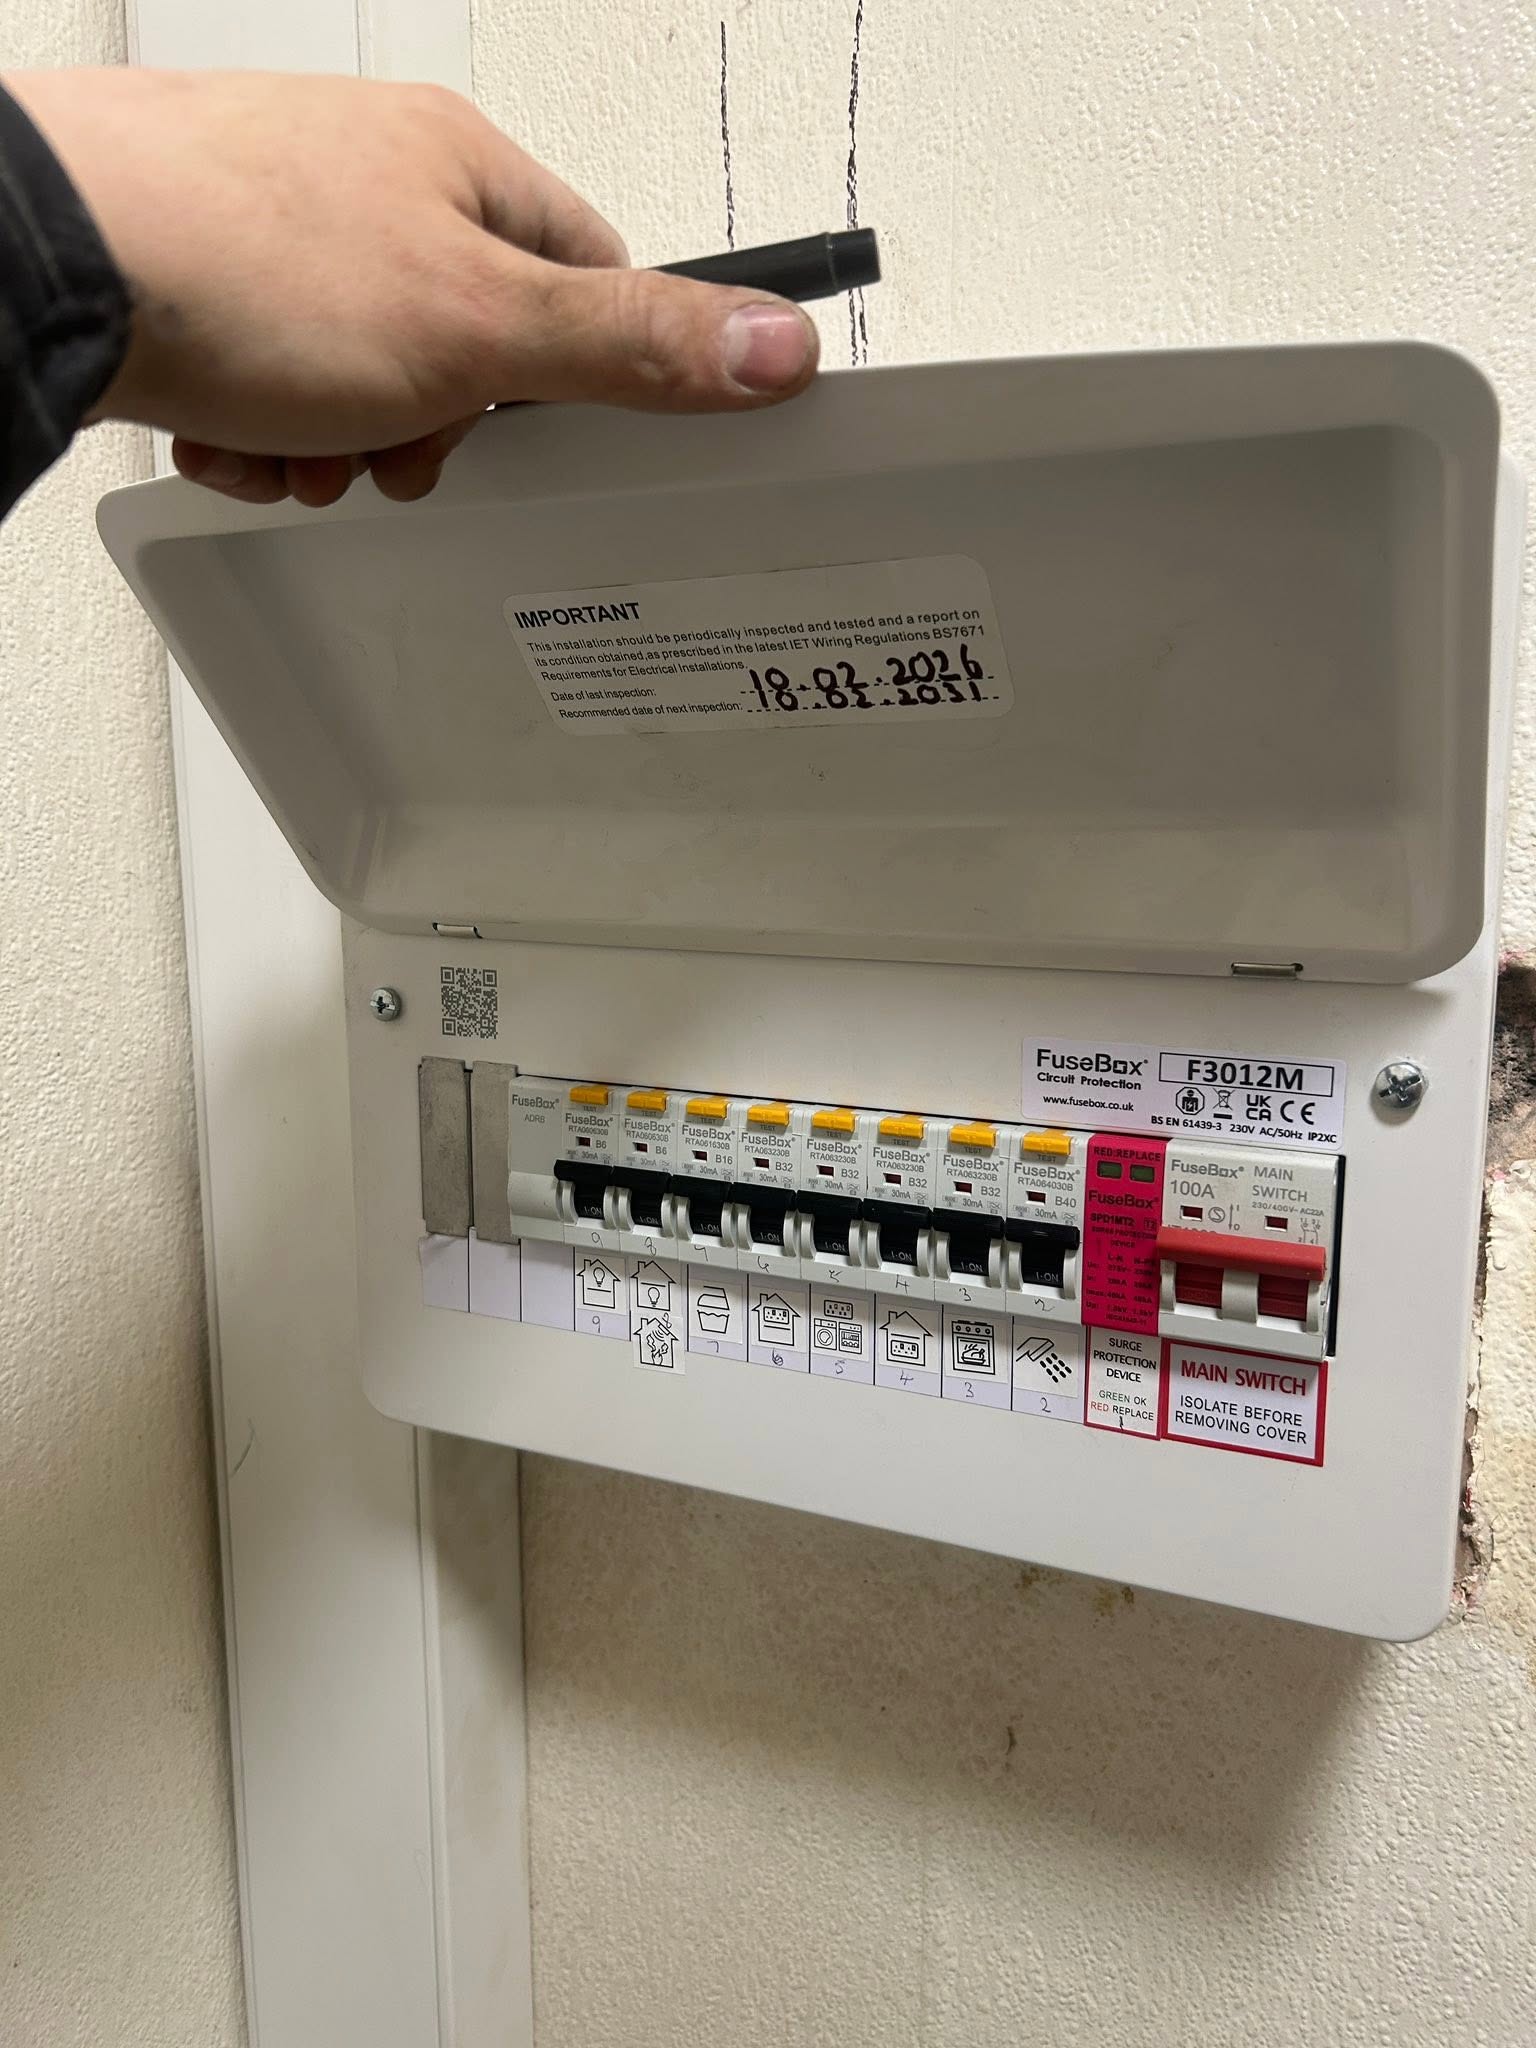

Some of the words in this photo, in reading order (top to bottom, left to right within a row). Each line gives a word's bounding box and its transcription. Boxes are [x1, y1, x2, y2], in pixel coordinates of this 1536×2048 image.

[514, 602, 640, 629] IMPORTANT
[527, 642, 551, 653] This
[553, 637, 614, 651] installation
[616, 634, 653, 647] should
[655, 633, 671, 644] be
[673, 627, 741, 645] periodically
[744, 623, 804, 639] inspected
[808, 620, 831, 632] and
[834, 616, 875, 630] tested
[878, 615, 903, 627] and
[906, 615, 915, 624] a
[917, 610, 959, 625] report
[962, 609, 980, 620] on
[534, 657, 548, 667] its
[549, 654, 597, 667] condition
[597, 650, 661, 664] obtained,as
[662, 644, 721, 660] prescribed
[723, 644, 733, 654] in
[734, 642, 754, 653] the
[756, 640, 787, 652] latest
[790, 638, 814, 650] IET
[813, 634, 853, 649] Wiring
[855, 628, 931, 646] Regulations
[933, 625, 984, 640] BS7671
[540, 668, 612, 683] Requirements
[612, 667, 628, 677] for
[629, 662, 678, 676] Electrical
[678, 660, 749, 673] Installations.
[551, 691, 574, 702] Date
[575, 690, 585, 700] of
[585, 689, 604, 699] last
[604, 687, 657, 700] inspection:
[559, 705, 631, 719] Recommended
[632, 705, 654, 716] date
[655, 704, 664, 714] of
[666, 704, 687, 714] next
[688, 701, 743, 715] inspection:
[1037, 1072, 1075, 1084] Circuit
[1080, 1075, 1142, 1090] Protection
[1187, 1059, 1304, 1091] F3012M
[1043, 1095, 1134, 1112] www.fusebox.co.uk
[1246, 1093, 1272, 1109] UK
[1151, 1116, 1163, 1126] BS
[1166, 1117, 1180, 1127] EN
[1182, 1119, 1222, 1132] 61439-3
[1230, 1124, 1255, 1135] 230V
[1259, 1128, 1303, 1140] AC/50Hz
[1308, 1132, 1337, 1144] IP2XC
[596, 1140, 607, 1149] B6
[655, 1145, 667, 1155] B6
[744, 1145, 790, 1157] RTA063230B
[963, 1146, 982, 1154] TEST
[715, 1155, 733, 1165] B16
[810, 1152, 856, 1164] RTA063230B
[1037, 1154, 1057, 1162] TEST
[699, 1166, 718, 1176] 30mA
[775, 1162, 793, 1172] B32
[876, 1160, 924, 1172] RTA063230B
[1254, 1166, 1293, 1181] MAIN
[759, 1174, 778, 1183] 30mA
[841, 1169, 859, 1179] B32
[946, 1169, 998, 1181] RTA063230B
[824, 1181, 844, 1190] 30mA
[908, 1177, 927, 1188] B32
[1017, 1177, 1074, 1192] RTA064030B
[1171, 1179, 1215, 1199] 100A
[891, 1190, 911, 1199] 30mA
[980, 1186, 1001, 1197] B32
[1252, 1185, 1308, 1202] SWITCH
[962, 1198, 983, 1209] 30mA
[1055, 1196, 1077, 1208] B40
[1034, 1208, 1057, 1219] 30mA
[959, 1287, 972, 1302] 3
[592, 1315, 601, 1333] 9
[1109, 1337, 1142, 1352] SURGE
[1093, 1350, 1157, 1370] PROTECTION
[900, 1369, 914, 1385] 4
[1106, 1368, 1141, 1383] DEVICE
[1181, 1359, 1228, 1384] MAIN
[1235, 1368, 1307, 1396] SWITCH
[964, 1382, 975, 1398] 3
[1040, 1397, 1051, 1413] 2
[1099, 1390, 1130, 1403] GREEN
[1134, 1396, 1147, 1406] OK
[1091, 1401, 1109, 1412] RED
[1113, 1405, 1154, 1421] REPLACE
[1180, 1395, 1238, 1416] ISOLATE
[1244, 1406, 1303, 1427] BEFORE
[1175, 1410, 1250, 1434] REMOVING
[1256, 1424, 1307, 1444] COVER
